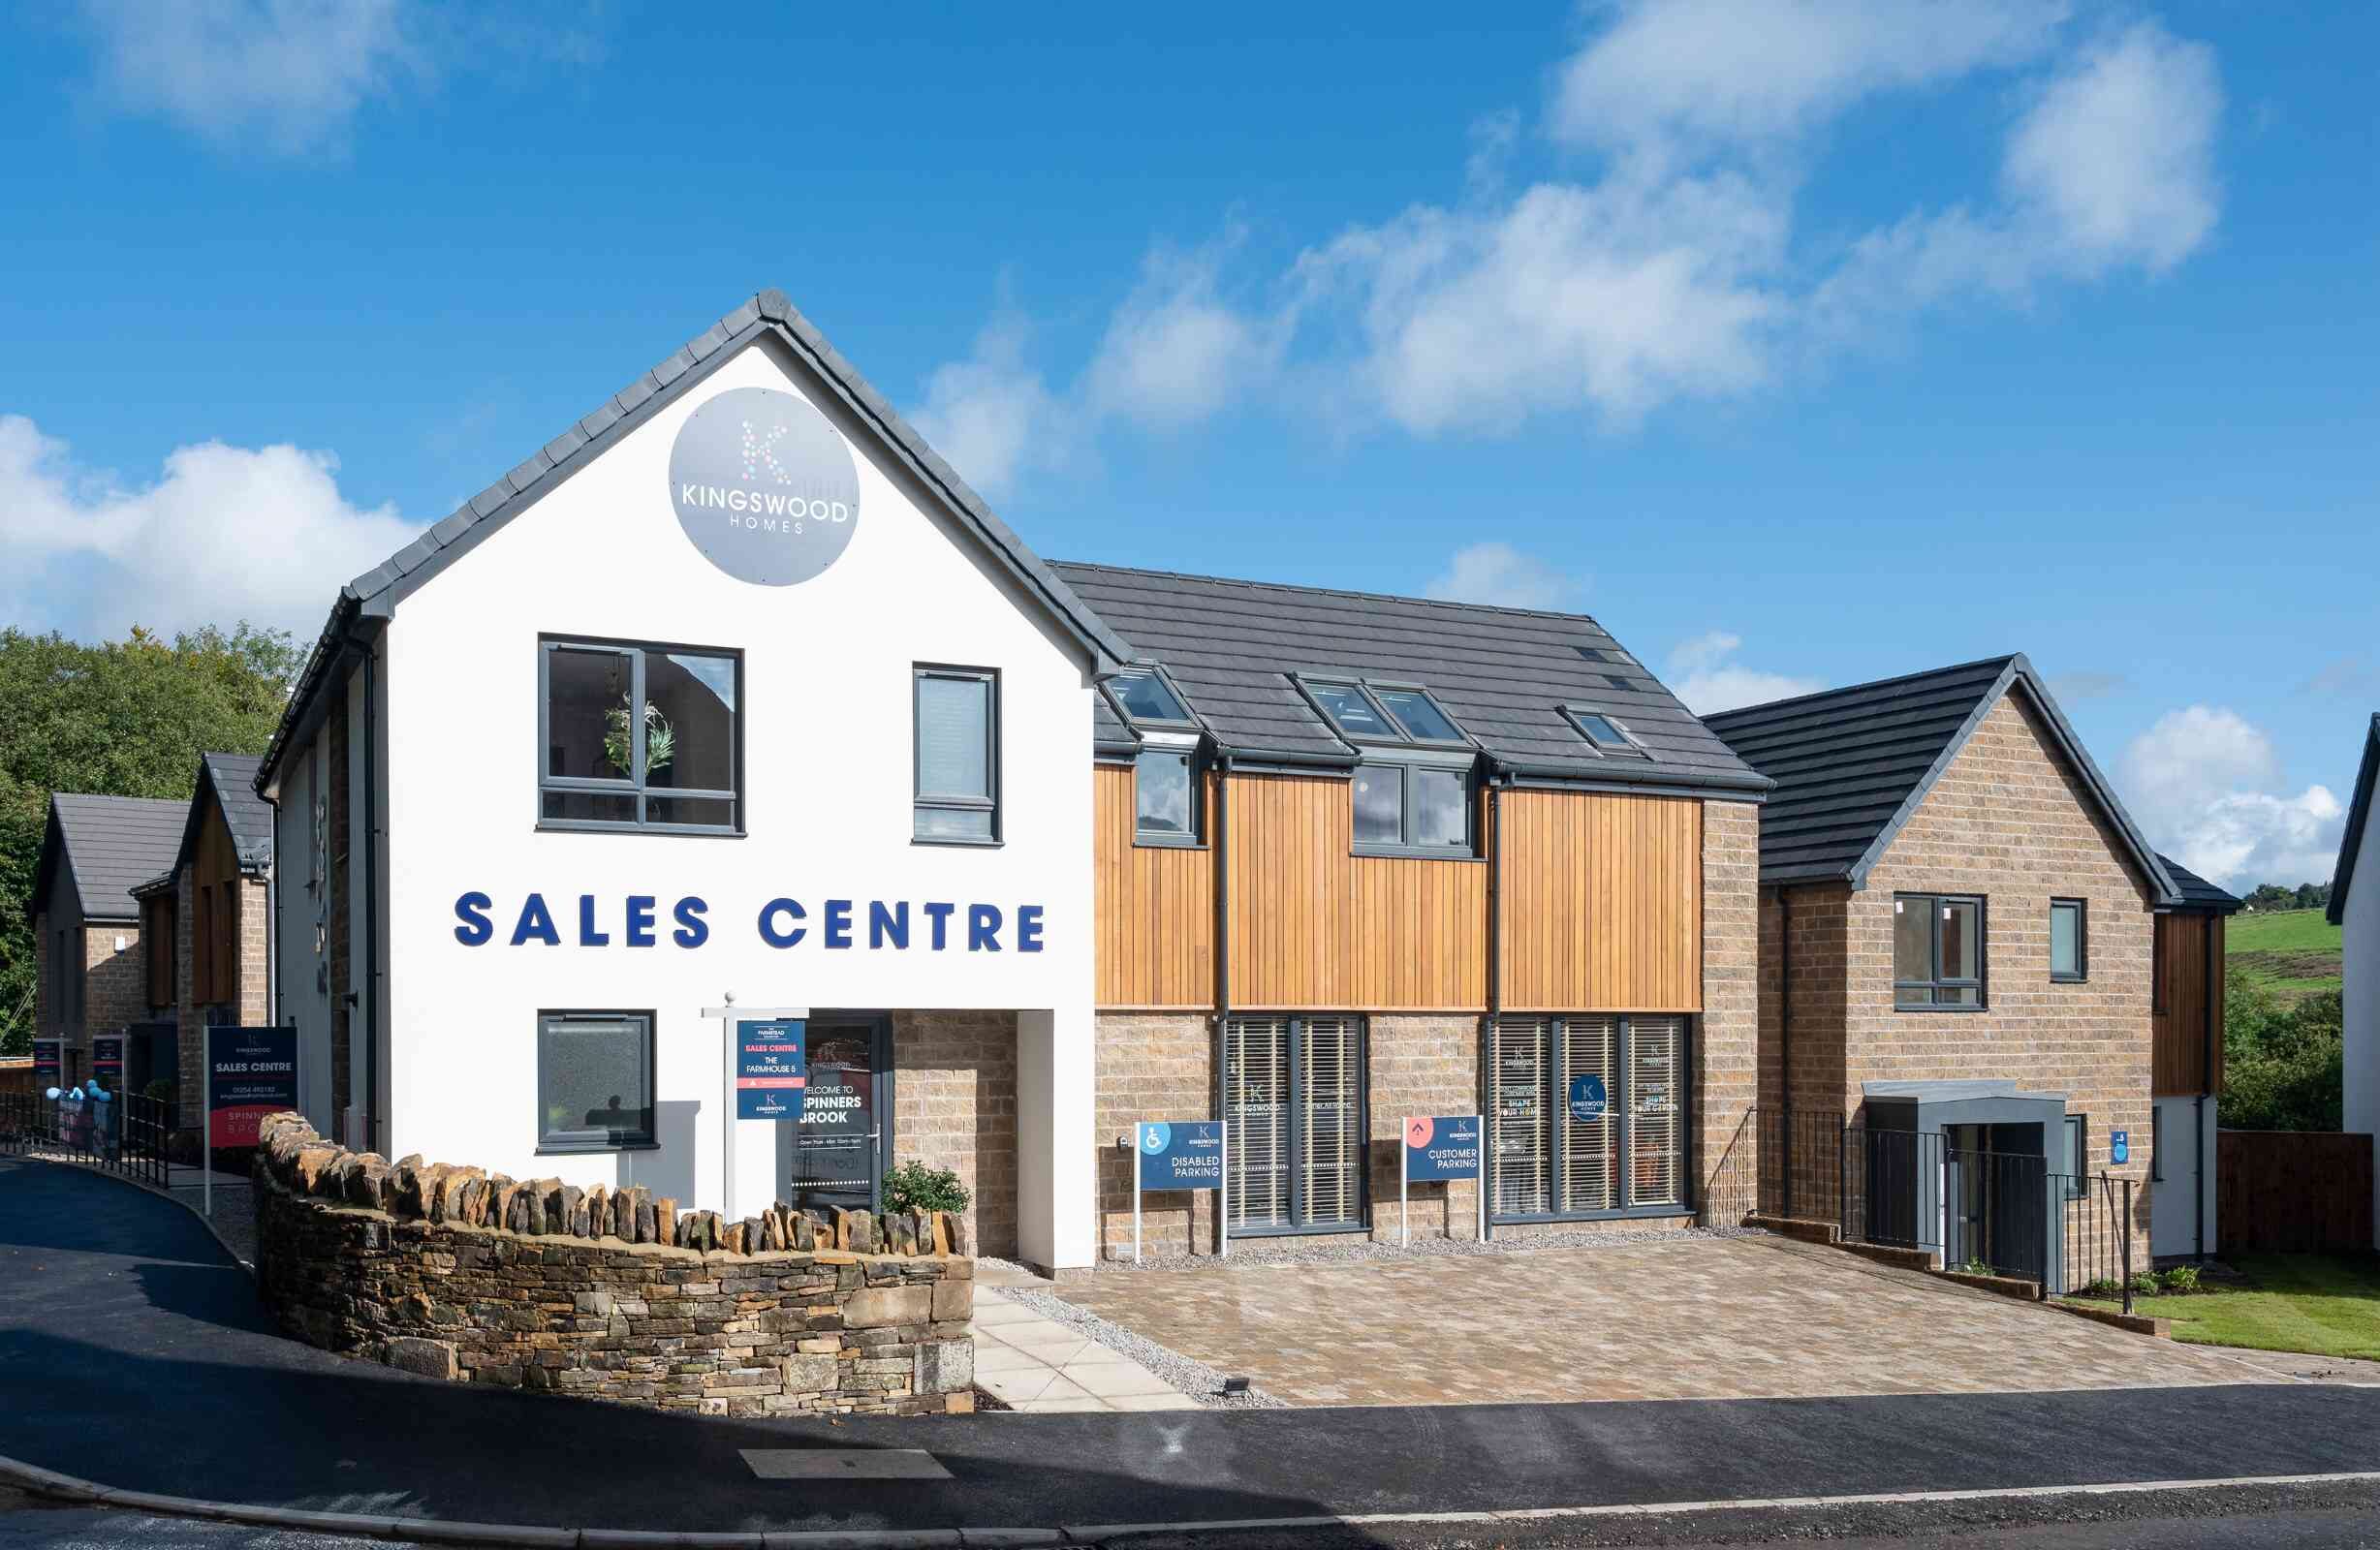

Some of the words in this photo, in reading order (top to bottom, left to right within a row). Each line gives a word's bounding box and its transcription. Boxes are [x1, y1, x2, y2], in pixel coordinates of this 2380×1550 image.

[682, 484, 849, 522] KINGSWOOD
[730, 514, 804, 535] HOMES
[454, 891, 709, 948] SALES
[758, 897, 1045, 952] CENTRE
[216, 1063, 248, 1072] SALES
[251, 1062, 292, 1071] CENTRE
[746, 1065, 790, 1073] FARMHOUSE
[843, 1085, 854, 1094] TO
[1428, 1149, 1478, 1161] CUSTOMER
[1172, 1156, 1219, 1167] DISABLED
[1437, 1159, 1478, 1169] PARKING
[1174, 1166, 1220, 1178] PARKING
